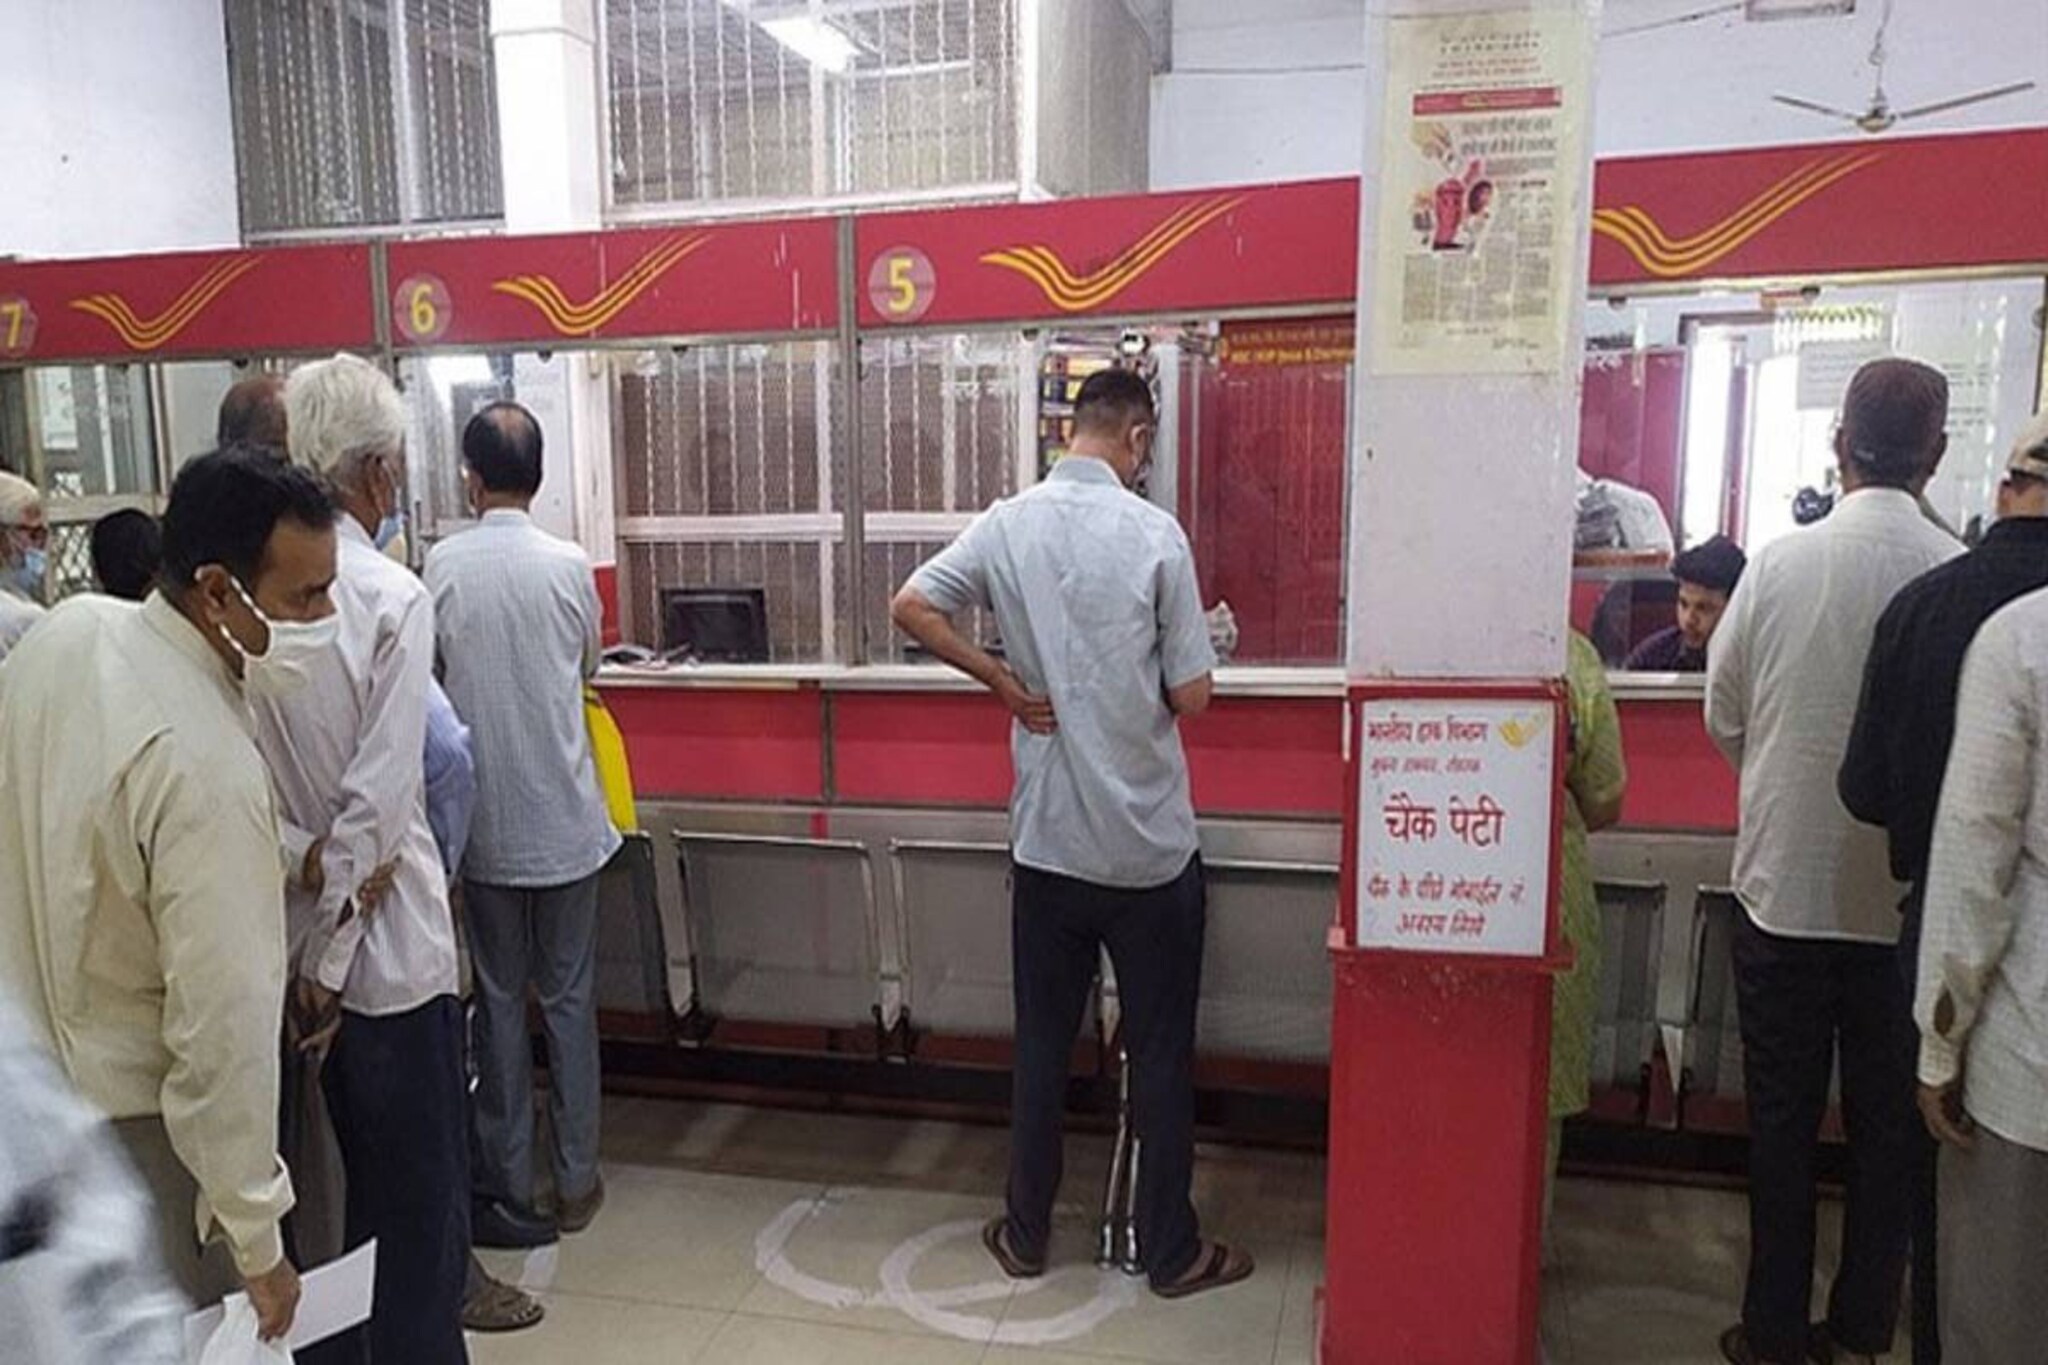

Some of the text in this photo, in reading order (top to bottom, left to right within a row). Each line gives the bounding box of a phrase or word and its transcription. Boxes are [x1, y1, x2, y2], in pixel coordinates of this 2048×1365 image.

[410, 282, 436, 335] 6
[889, 257, 916, 313] 5
[0, 301, 24, 350] 7
[1448, 794, 1505, 847] पेटी
